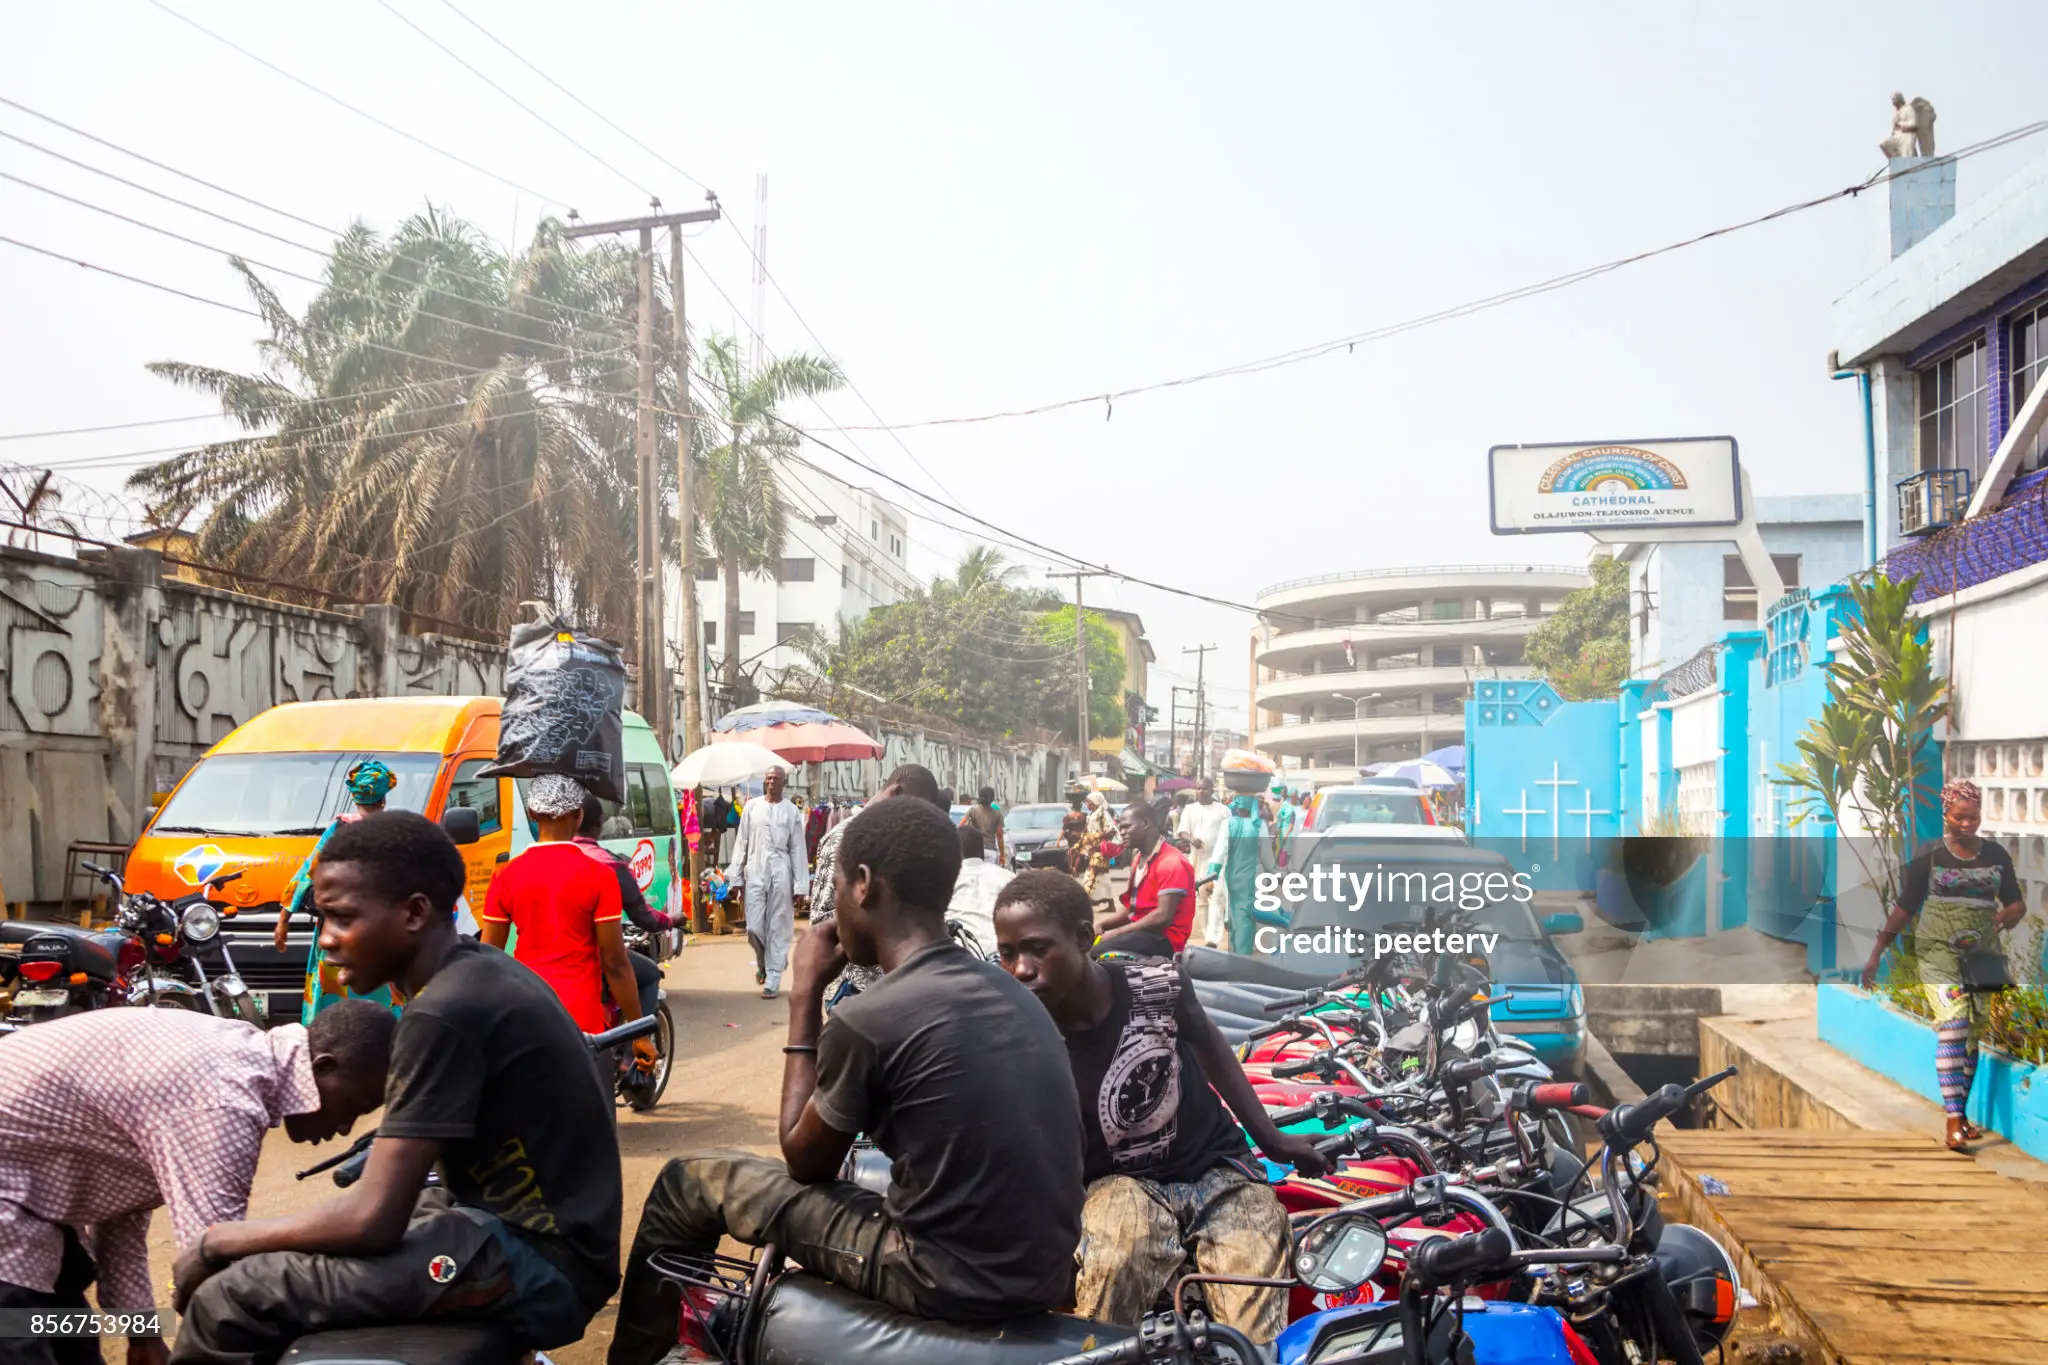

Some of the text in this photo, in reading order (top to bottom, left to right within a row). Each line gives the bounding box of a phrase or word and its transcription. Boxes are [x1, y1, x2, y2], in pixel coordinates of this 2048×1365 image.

[1583, 447, 1641, 457] CHURCH
[1642, 452, 1660, 463] OF
[1572, 495, 1655, 506] CATHEDRAL
[37, 944, 68, 952] BAJAJ
